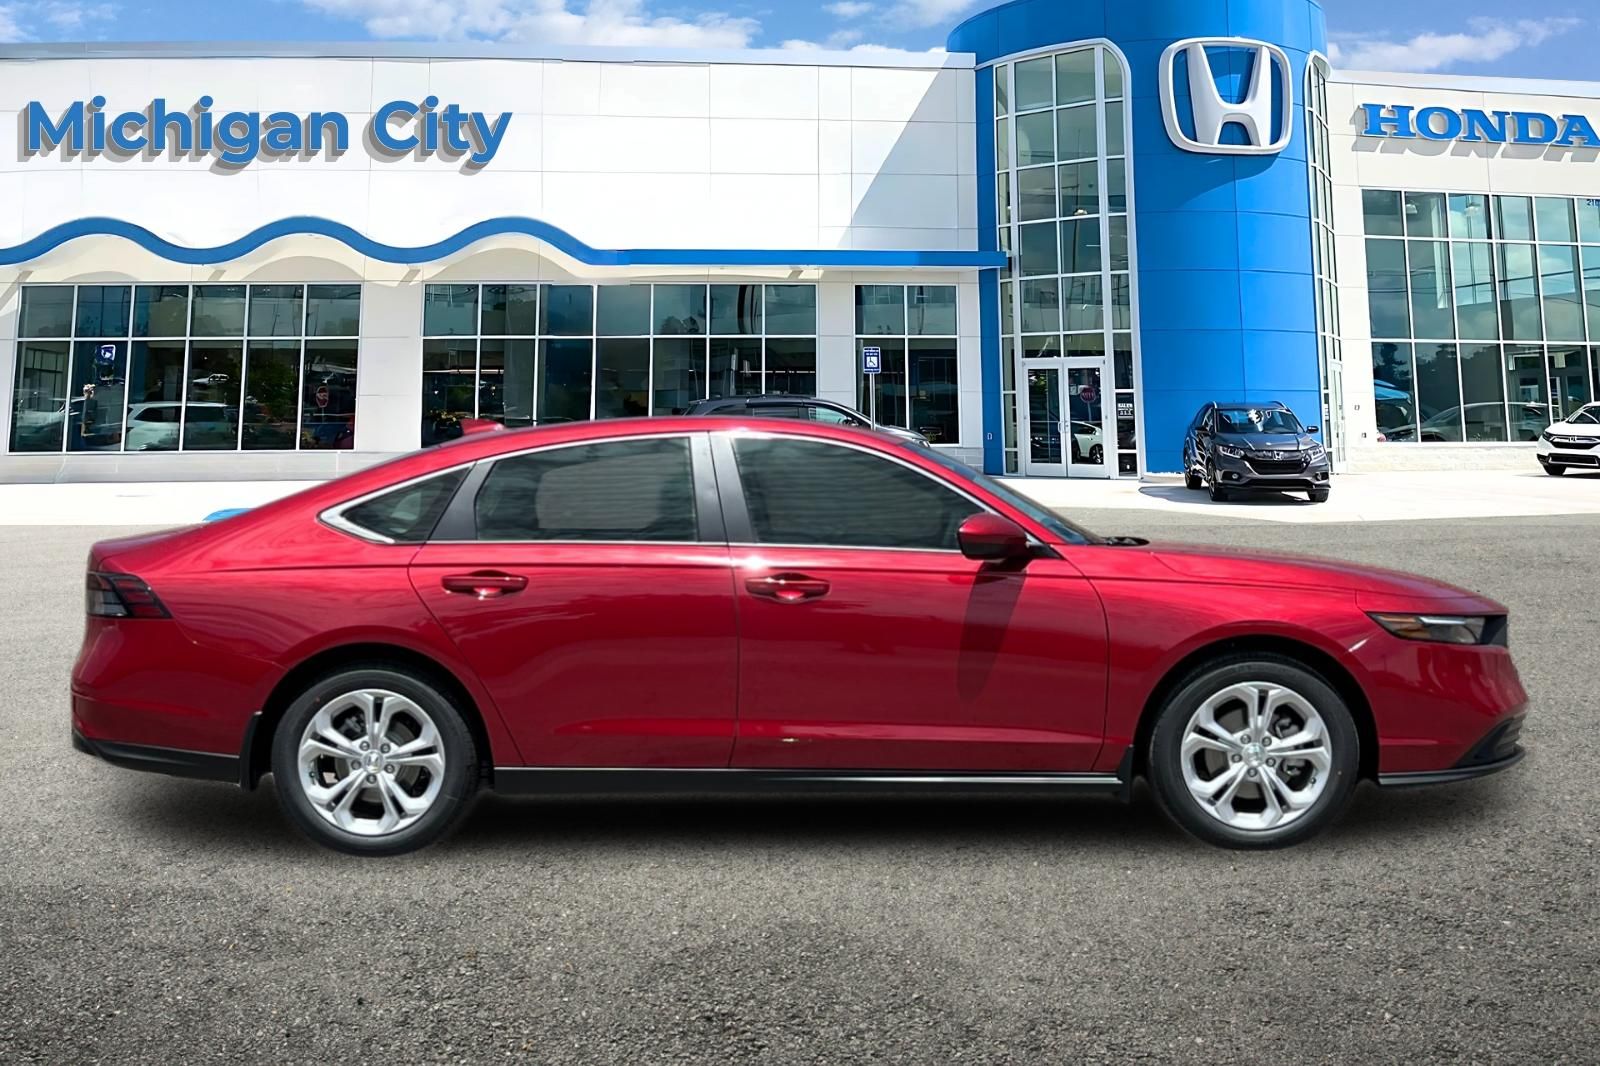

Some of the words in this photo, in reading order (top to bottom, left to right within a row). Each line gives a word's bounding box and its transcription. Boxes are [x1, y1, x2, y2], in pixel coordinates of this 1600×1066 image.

[28, 95, 349, 164] Michigan
[374, 95, 513, 164] City
[1361, 103, 1600, 147] HONDA
